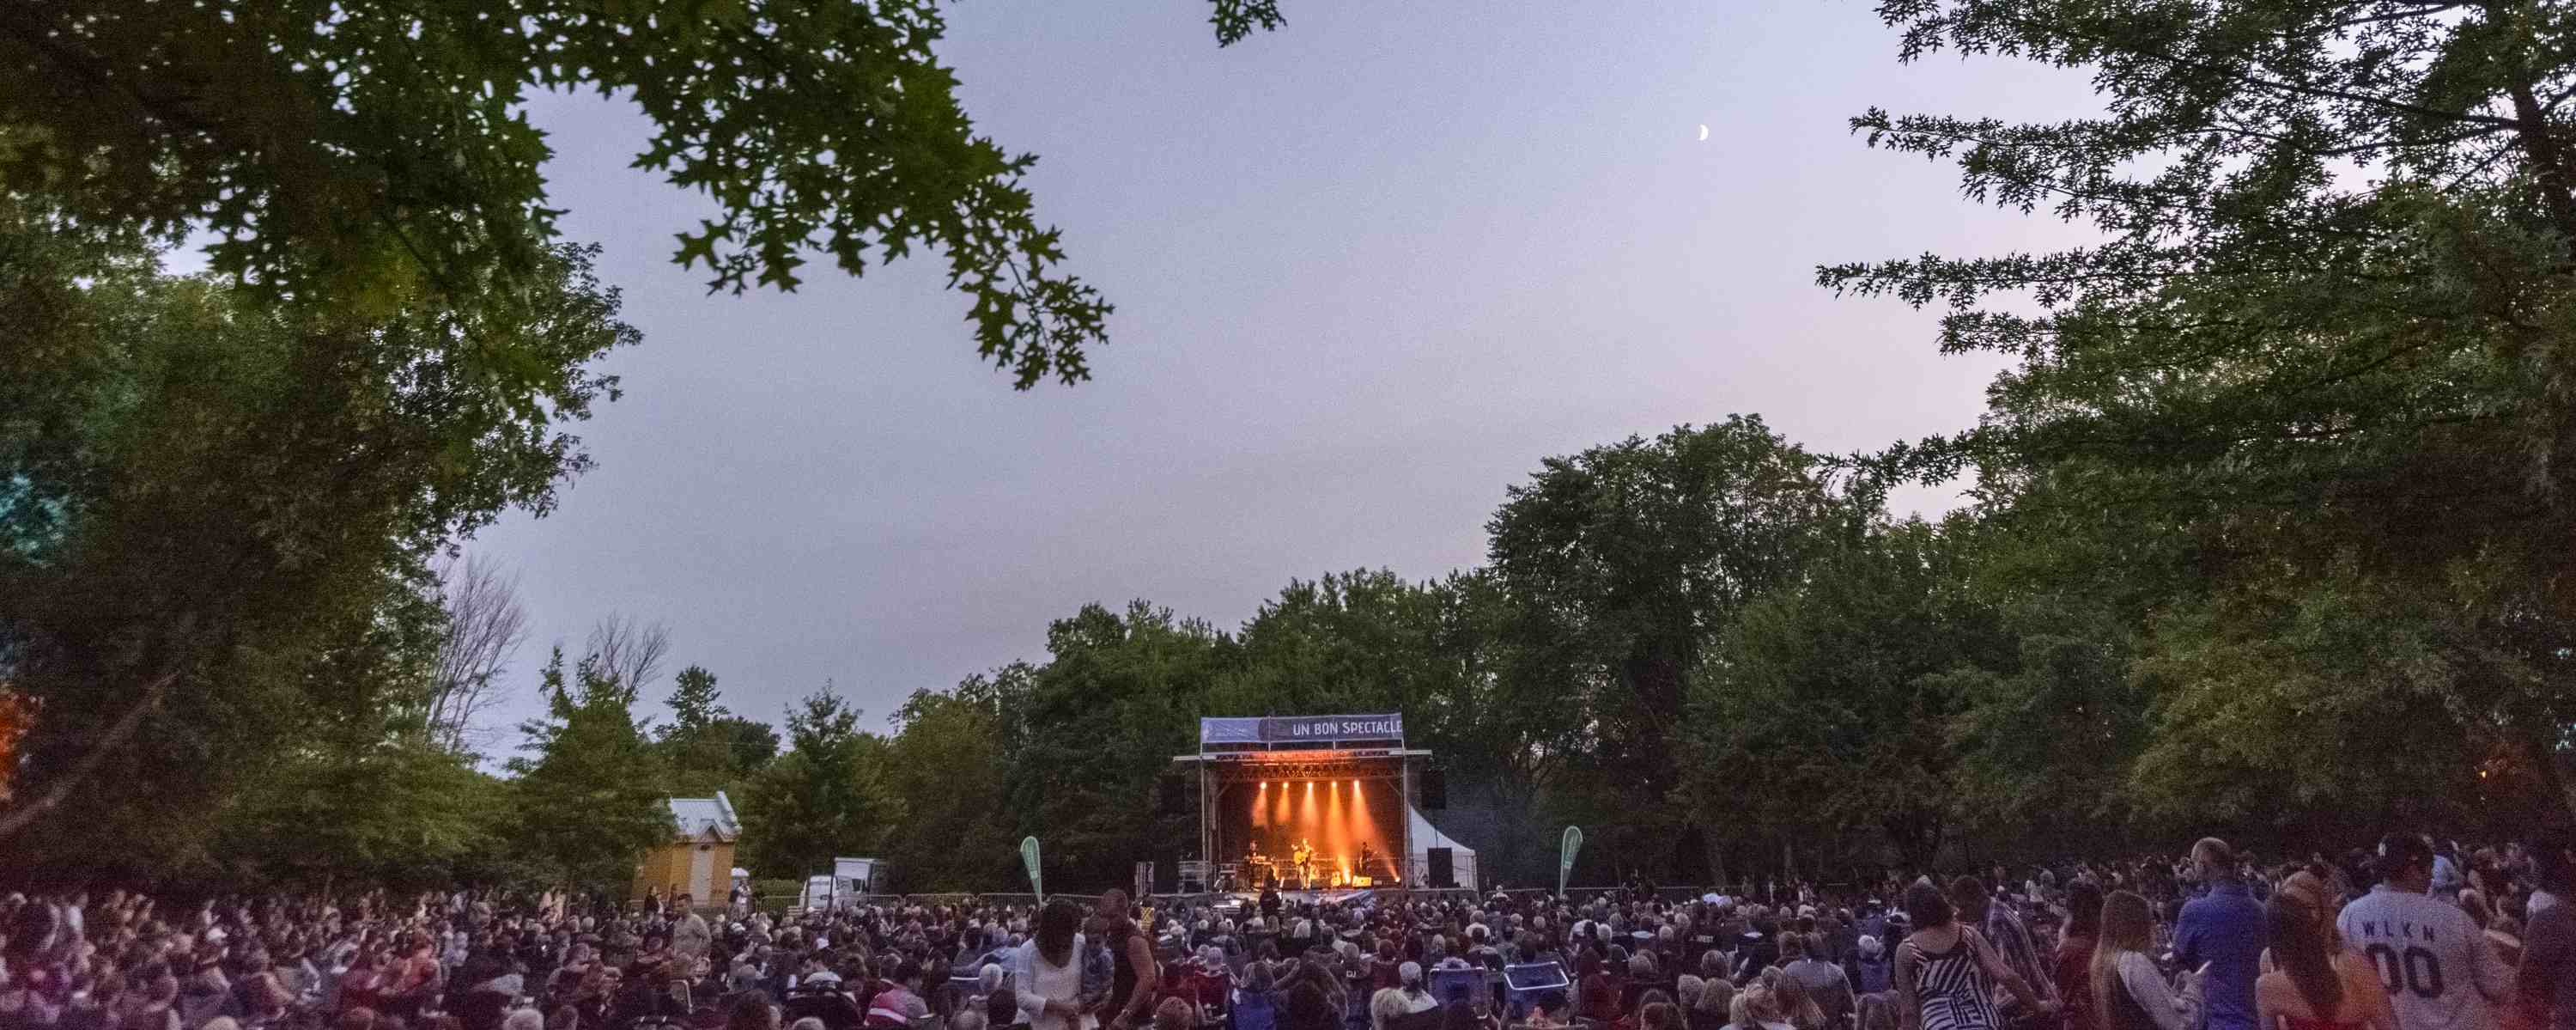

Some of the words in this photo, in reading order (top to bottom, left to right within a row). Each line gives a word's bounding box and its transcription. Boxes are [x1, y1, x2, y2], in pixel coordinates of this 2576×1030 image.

[1293, 723, 1309, 735] UN
[1315, 722, 1338, 734] BON
[1342, 721, 1402, 734] SPECTACLE
[2362, 920, 2435, 942] WLKN
